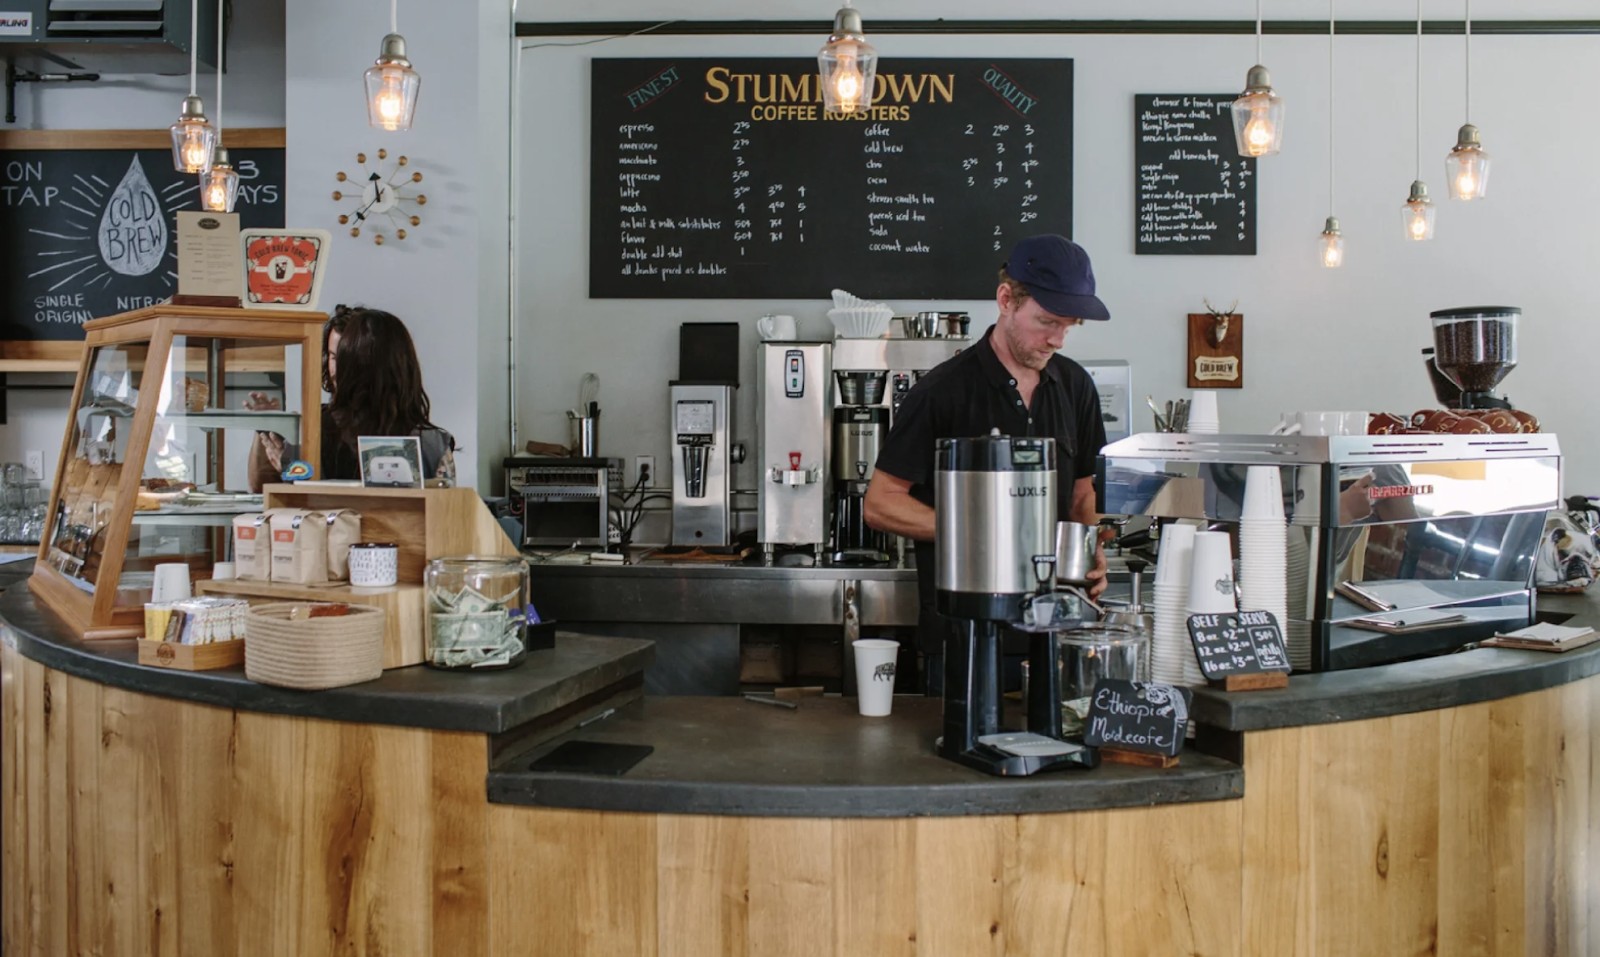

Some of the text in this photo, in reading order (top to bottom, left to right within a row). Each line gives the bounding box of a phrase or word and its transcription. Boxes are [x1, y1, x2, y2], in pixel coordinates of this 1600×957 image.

[626, 65, 679, 109] FINEST
[704, 66, 955, 103] STUMOWN
[983, 68, 1038, 114] QUALITY
[751, 104, 911, 121] COFFEE ROASTERS
[618, 123, 655, 139] espresso
[864, 124, 890, 137] coffee
[964, 124, 975, 135] 2
[1024, 124, 1035, 136] 3
[864, 140, 880, 154] cold
[882, 140, 904, 153] brew
[996, 142, 1006, 154] 3
[736, 156, 745, 166] 3
[6, 160, 43, 182] ON
[238, 160, 260, 180] 3
[0, 186, 60, 208] TAP
[237, 184, 278, 205] AYS
[620, 186, 640, 198] latte
[109, 188, 156, 228] COLD
[620, 202, 648, 213] mocha
[737, 202, 746, 214] 4
[993, 225, 1003, 236] 2
[106, 219, 163, 266] BREW
[868, 238, 902, 252] coconut
[905, 241, 930, 253] water
[621, 263, 632, 276] all
[698, 262, 727, 276] doubles
[34, 293, 84, 308] SINGLE
[1009, 486, 1048, 497] LUXUS
[1192, 612, 1270, 628] SELF SERVE
[1196, 631, 1206, 644] 8
[1199, 646, 1214, 657] 12
[1204, 661, 1218, 673] 16
